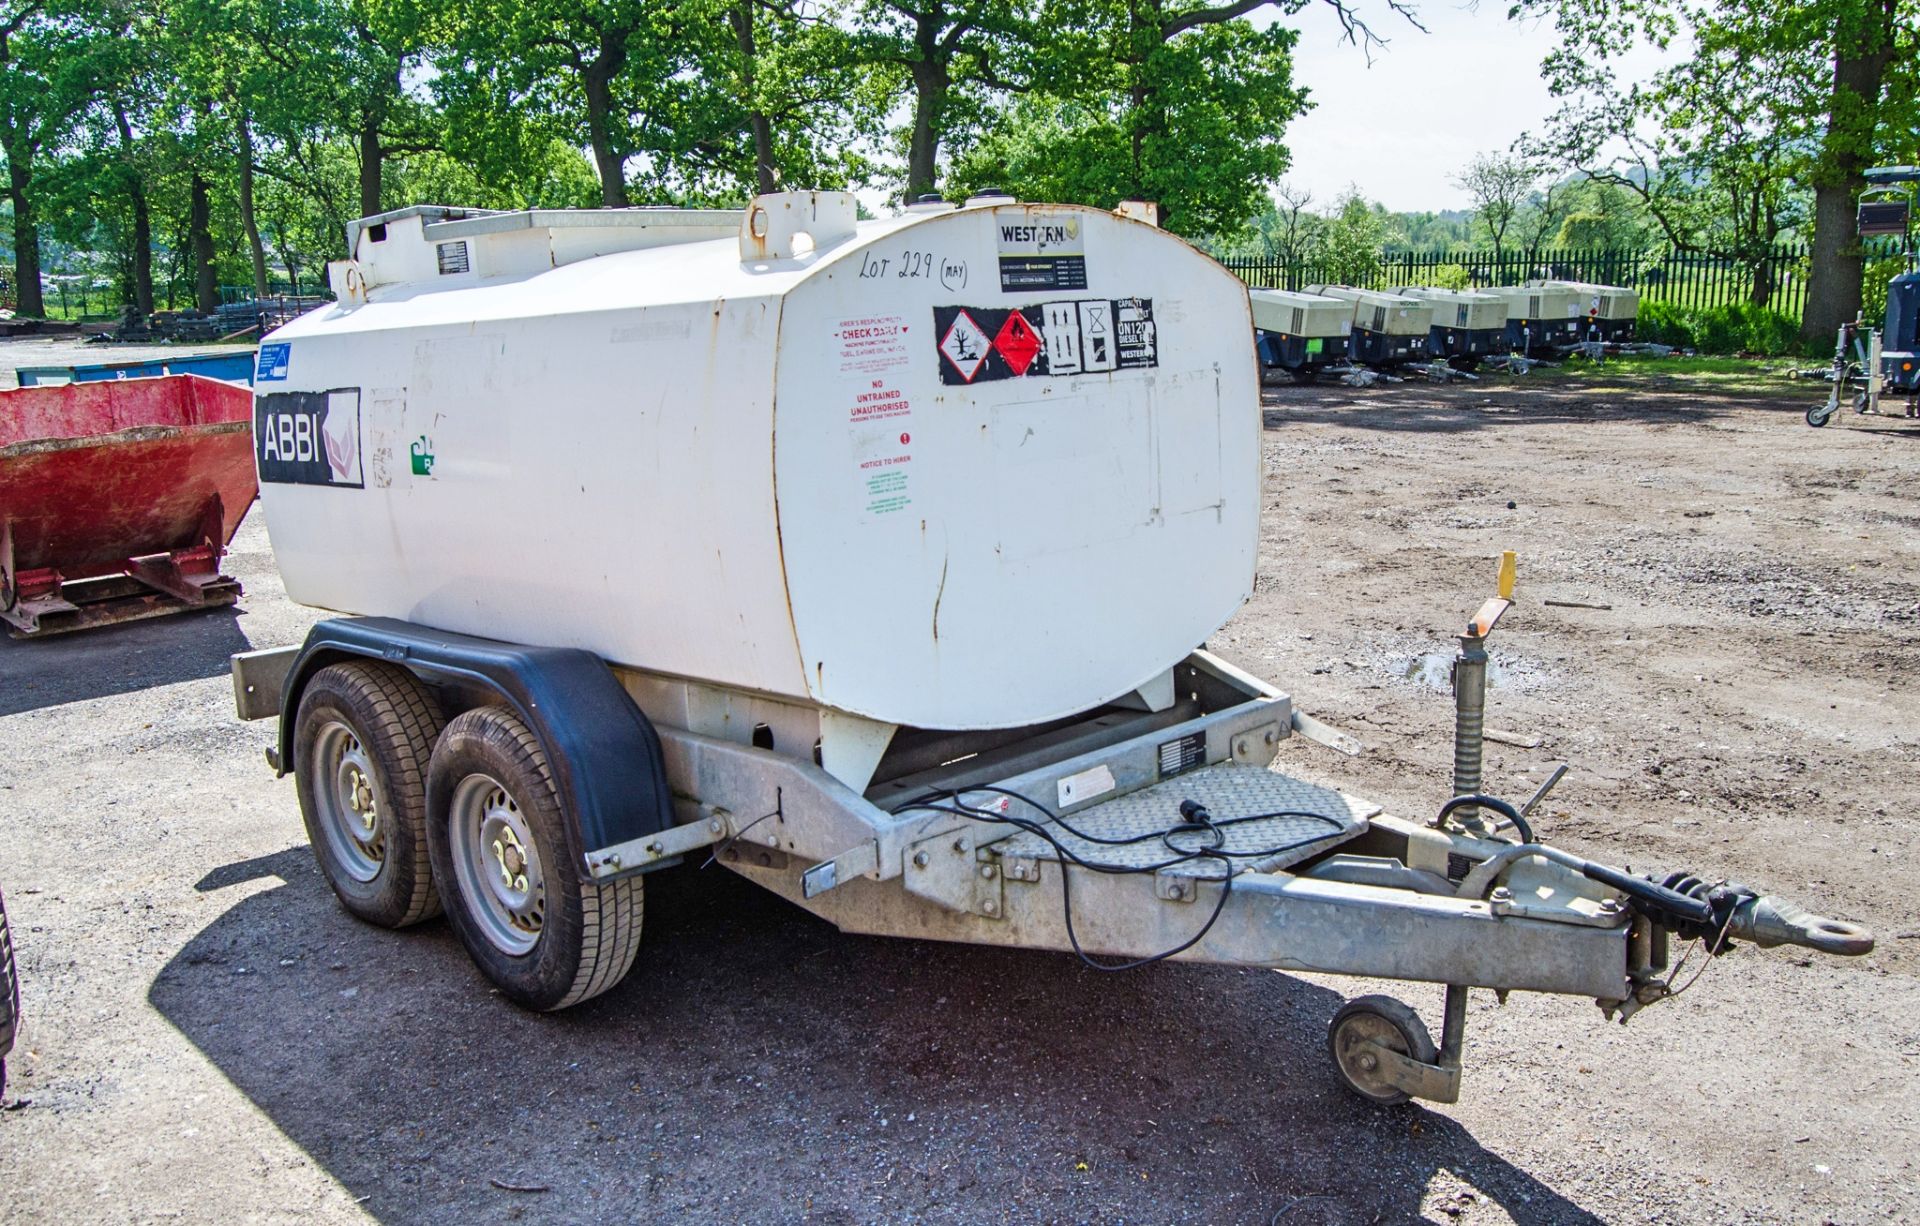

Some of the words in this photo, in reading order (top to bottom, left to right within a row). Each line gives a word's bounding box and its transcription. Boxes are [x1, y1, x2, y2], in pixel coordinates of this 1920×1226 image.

[1001, 226, 1064, 242] WESTRN
[859, 251, 890, 278] LOT
[899, 251, 932, 278] 229
[941, 257, 967, 292] (MAY)
[1118, 300, 1142, 308] CAPATY
[842, 328, 872, 340] CHECK
[1118, 321, 1149, 336] UN120
[1118, 334, 1138, 344] DIESEL
[872, 380, 883, 389] NO
[857, 390, 901, 403] UNTRAINED
[851, 401, 909, 416] UNAUTHORISED
[264, 413, 320, 462] ABBI
[861, 459, 882, 469] NOTICE
[884, 458, 892, 466] TO
[893, 455, 911, 464] HIRER
